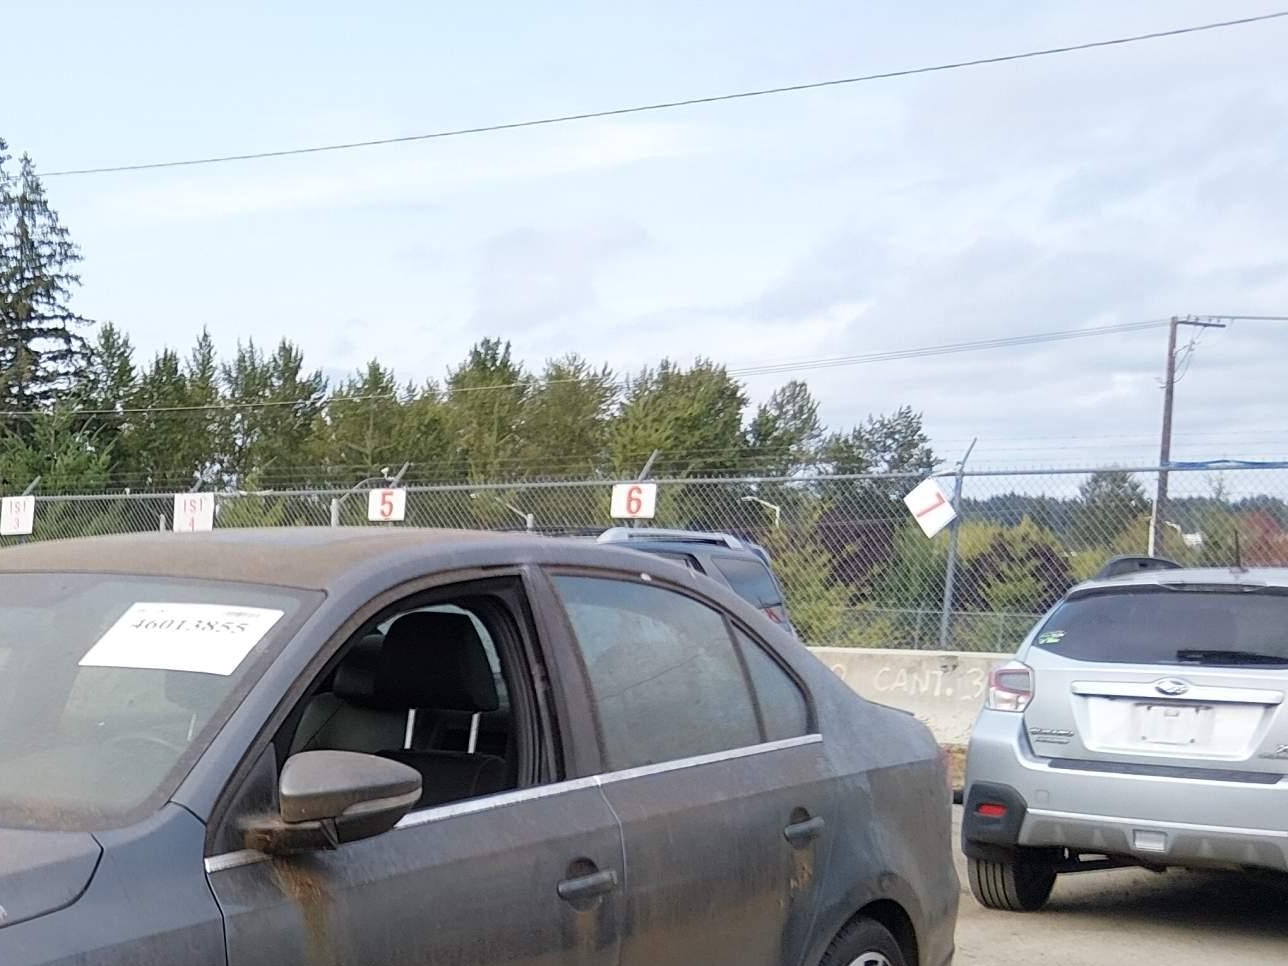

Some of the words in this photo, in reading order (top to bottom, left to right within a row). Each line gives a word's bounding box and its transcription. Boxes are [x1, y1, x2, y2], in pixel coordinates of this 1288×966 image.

[380, 490, 394, 517] 5
[626, 485, 642, 515] 6
[130, 618, 250, 635] 46013855
